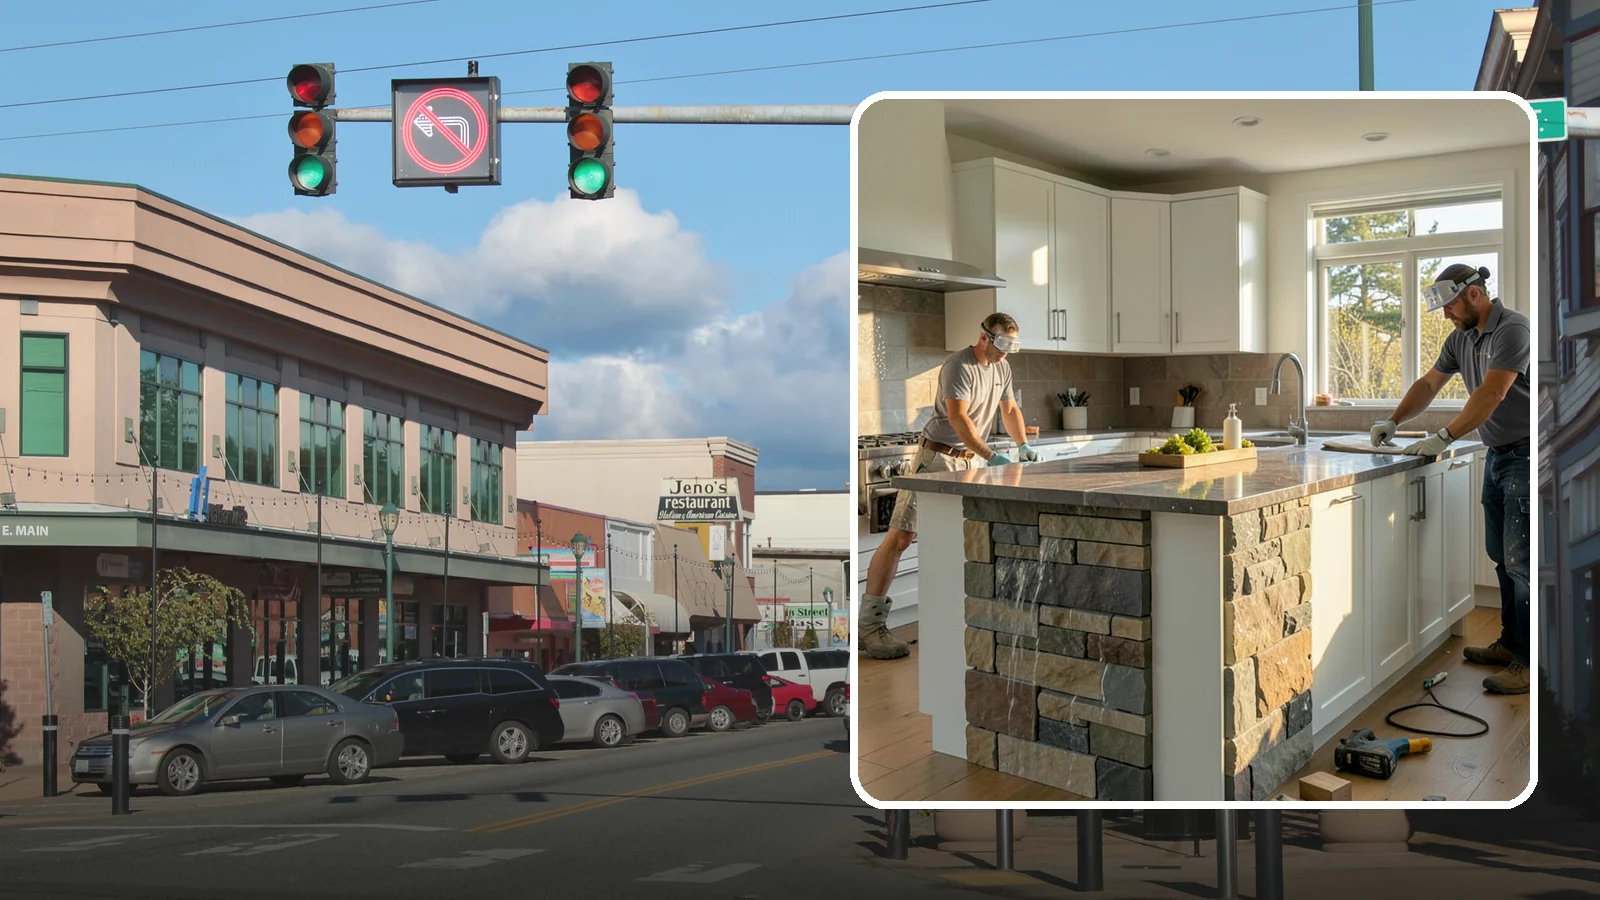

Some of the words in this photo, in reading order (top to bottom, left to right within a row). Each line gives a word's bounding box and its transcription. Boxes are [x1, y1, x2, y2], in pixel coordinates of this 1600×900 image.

[670, 480, 728, 494] Jeno's
[665, 497, 731, 509] restaurant
[659, 510, 681, 519] Italian
[686, 510, 714, 519] American
[715, 509, 738, 519] Cuisine
[2, 525, 13, 536] E.
[15, 525, 49, 537] MAIN
[797, 606, 829, 617] Street
